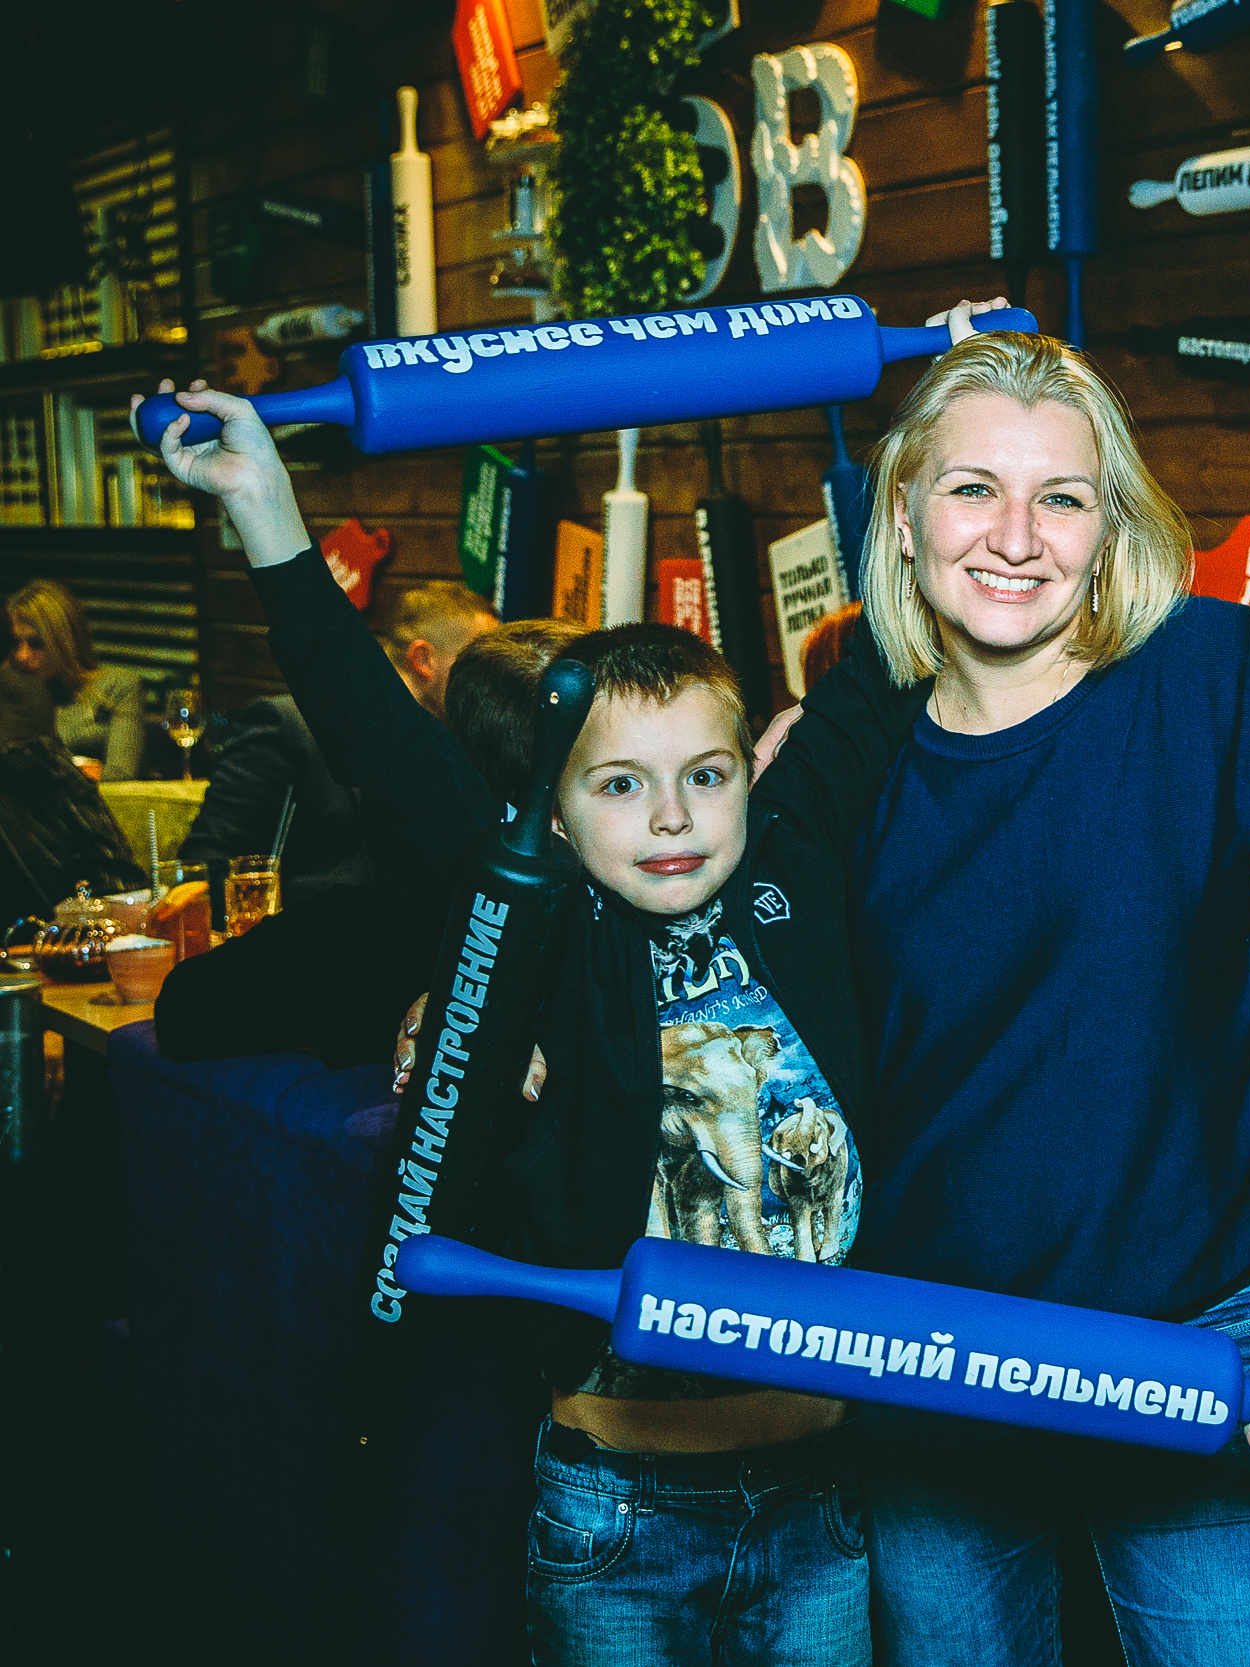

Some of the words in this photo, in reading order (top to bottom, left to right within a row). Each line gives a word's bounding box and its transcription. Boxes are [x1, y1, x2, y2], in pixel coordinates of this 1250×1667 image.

[1179, 163, 1245, 192] ЛЕПИМ
[411, 892, 510, 1163] НАСТРОЕНИЕ
[638, 1293, 955, 1381] настоящий
[964, 1350, 1229, 1425] пельмень
